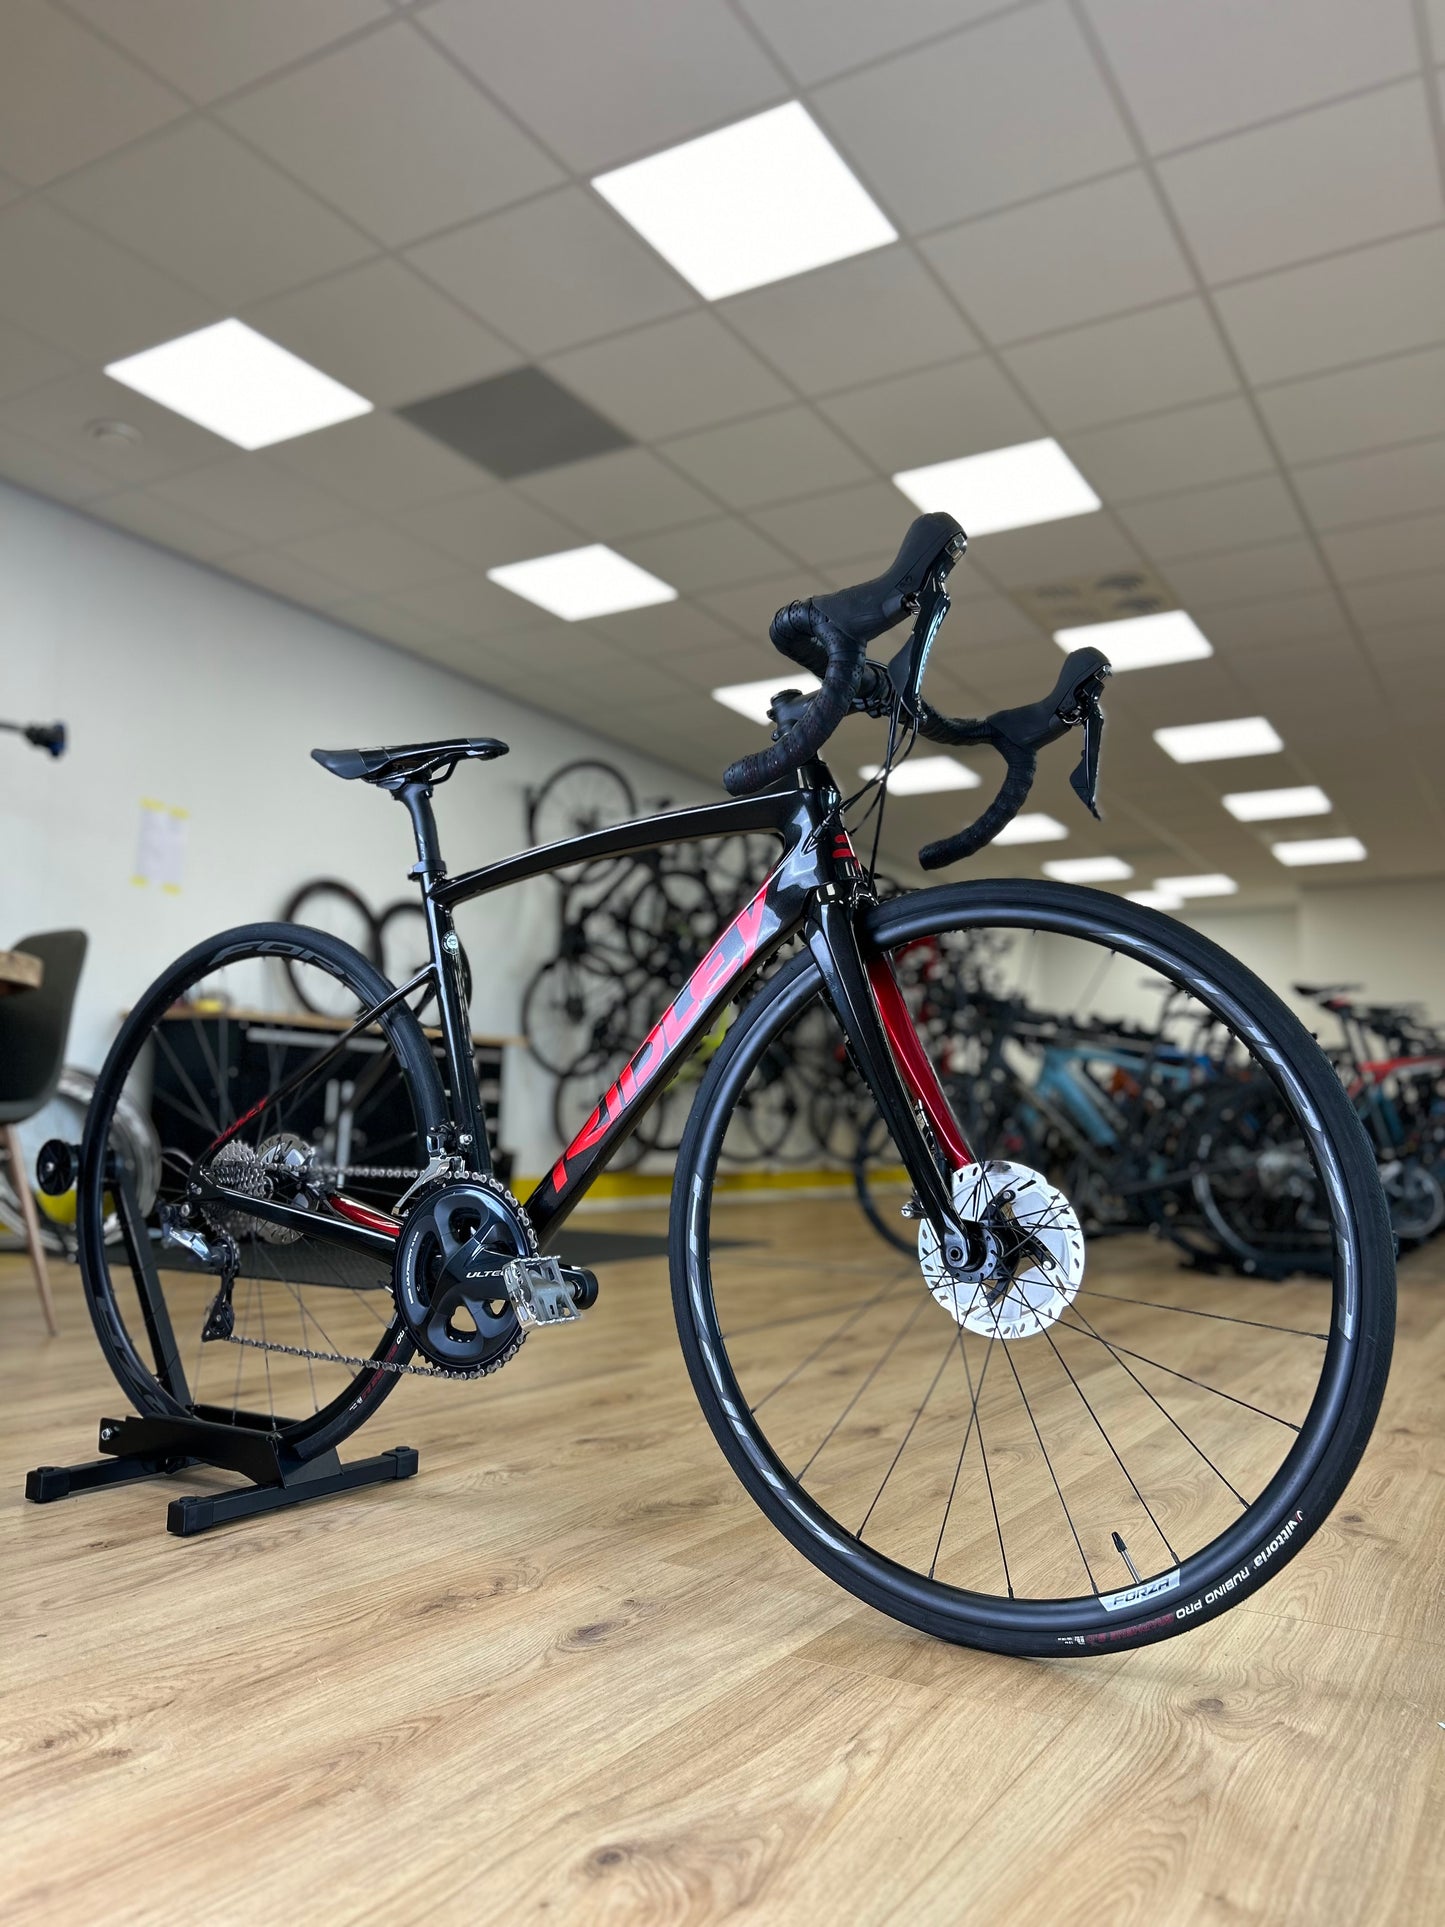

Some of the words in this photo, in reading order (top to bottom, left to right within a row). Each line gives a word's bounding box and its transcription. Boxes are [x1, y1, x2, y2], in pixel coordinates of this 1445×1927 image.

[552, 881, 768, 1193] RIDLEY
[466, 1270, 504, 1278] ULTE
[1253, 1519, 1299, 1568] vittoria
[1113, 1578, 1170, 1605] FORZA
[1204, 1566, 1250, 1604] RUBINO
[1175, 1599, 1203, 1619] PRO
